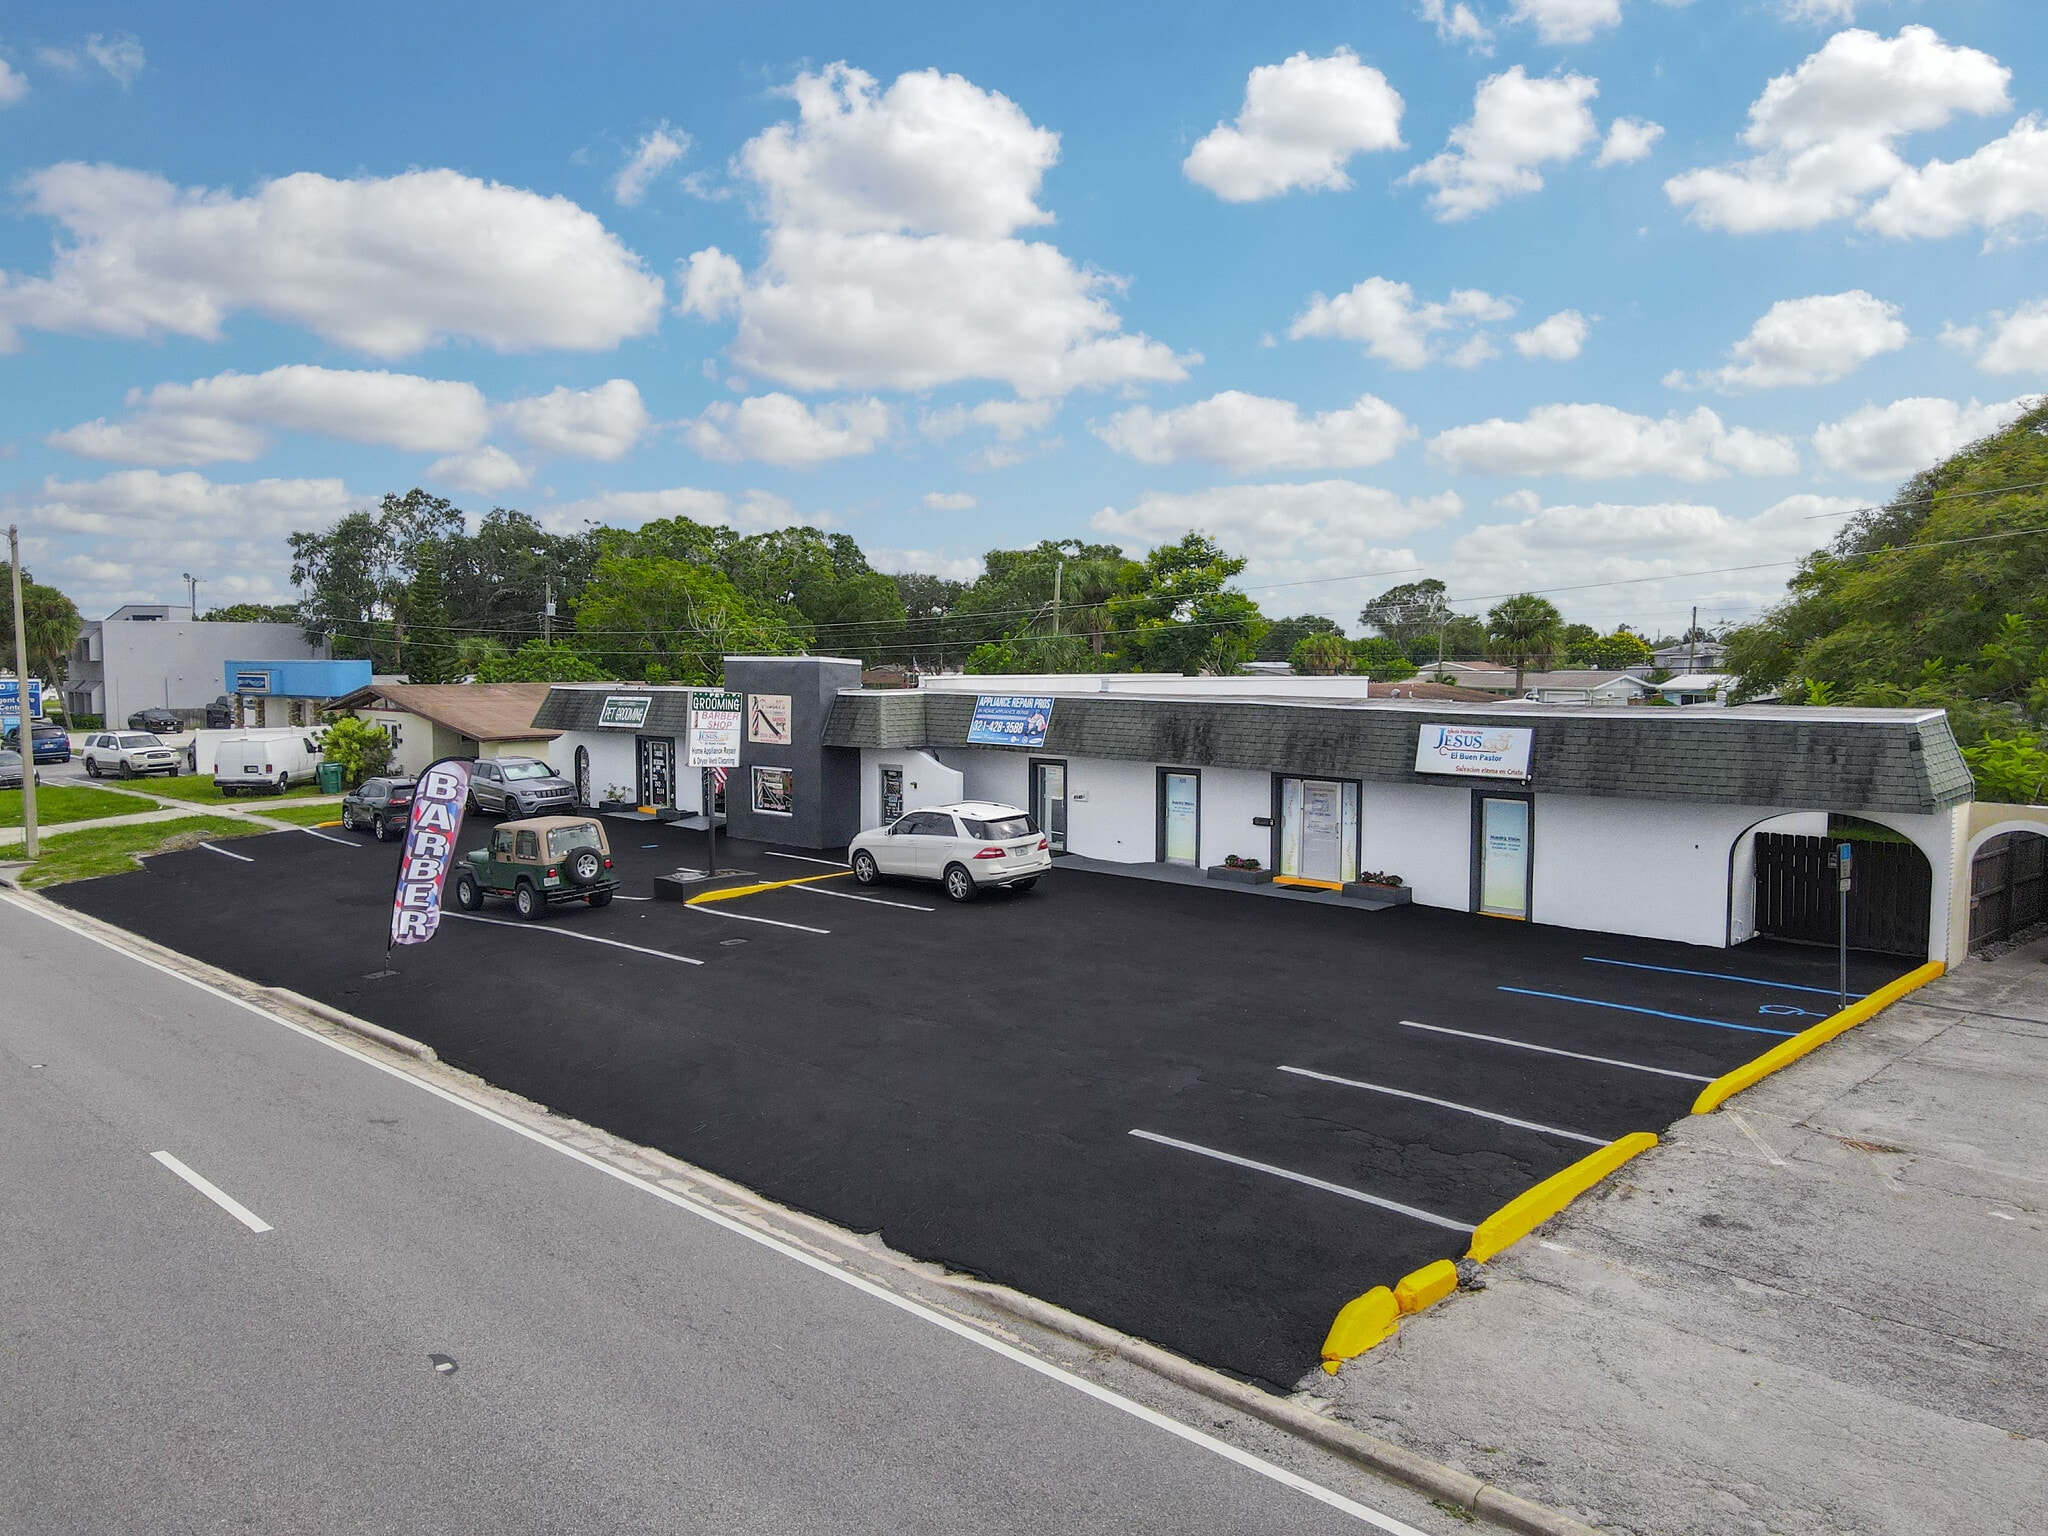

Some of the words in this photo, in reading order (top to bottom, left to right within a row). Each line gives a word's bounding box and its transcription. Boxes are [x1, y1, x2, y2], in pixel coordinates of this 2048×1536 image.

[693, 698, 740, 711] GROOMING
[979, 696, 1011, 708] APPLIANCE
[1011, 697, 1034, 708] REPAIR
[1034, 698, 1051, 709] PROS
[603, 706, 617, 720] PET
[615, 707, 644, 721] GROOMING
[702, 711, 739, 720] BARBER
[707, 720, 733, 729] SHOP
[972, 720, 1025, 734] 321-428-3588
[1433, 728, 1482, 749] JESUS
[1450, 752, 1458, 760] El
[1460, 753, 1477, 761] Buen
[1480, 753, 1502, 762] Pastor
[1507, 768, 1523, 776] Cristo
[398, 771, 459, 939] BARBER
